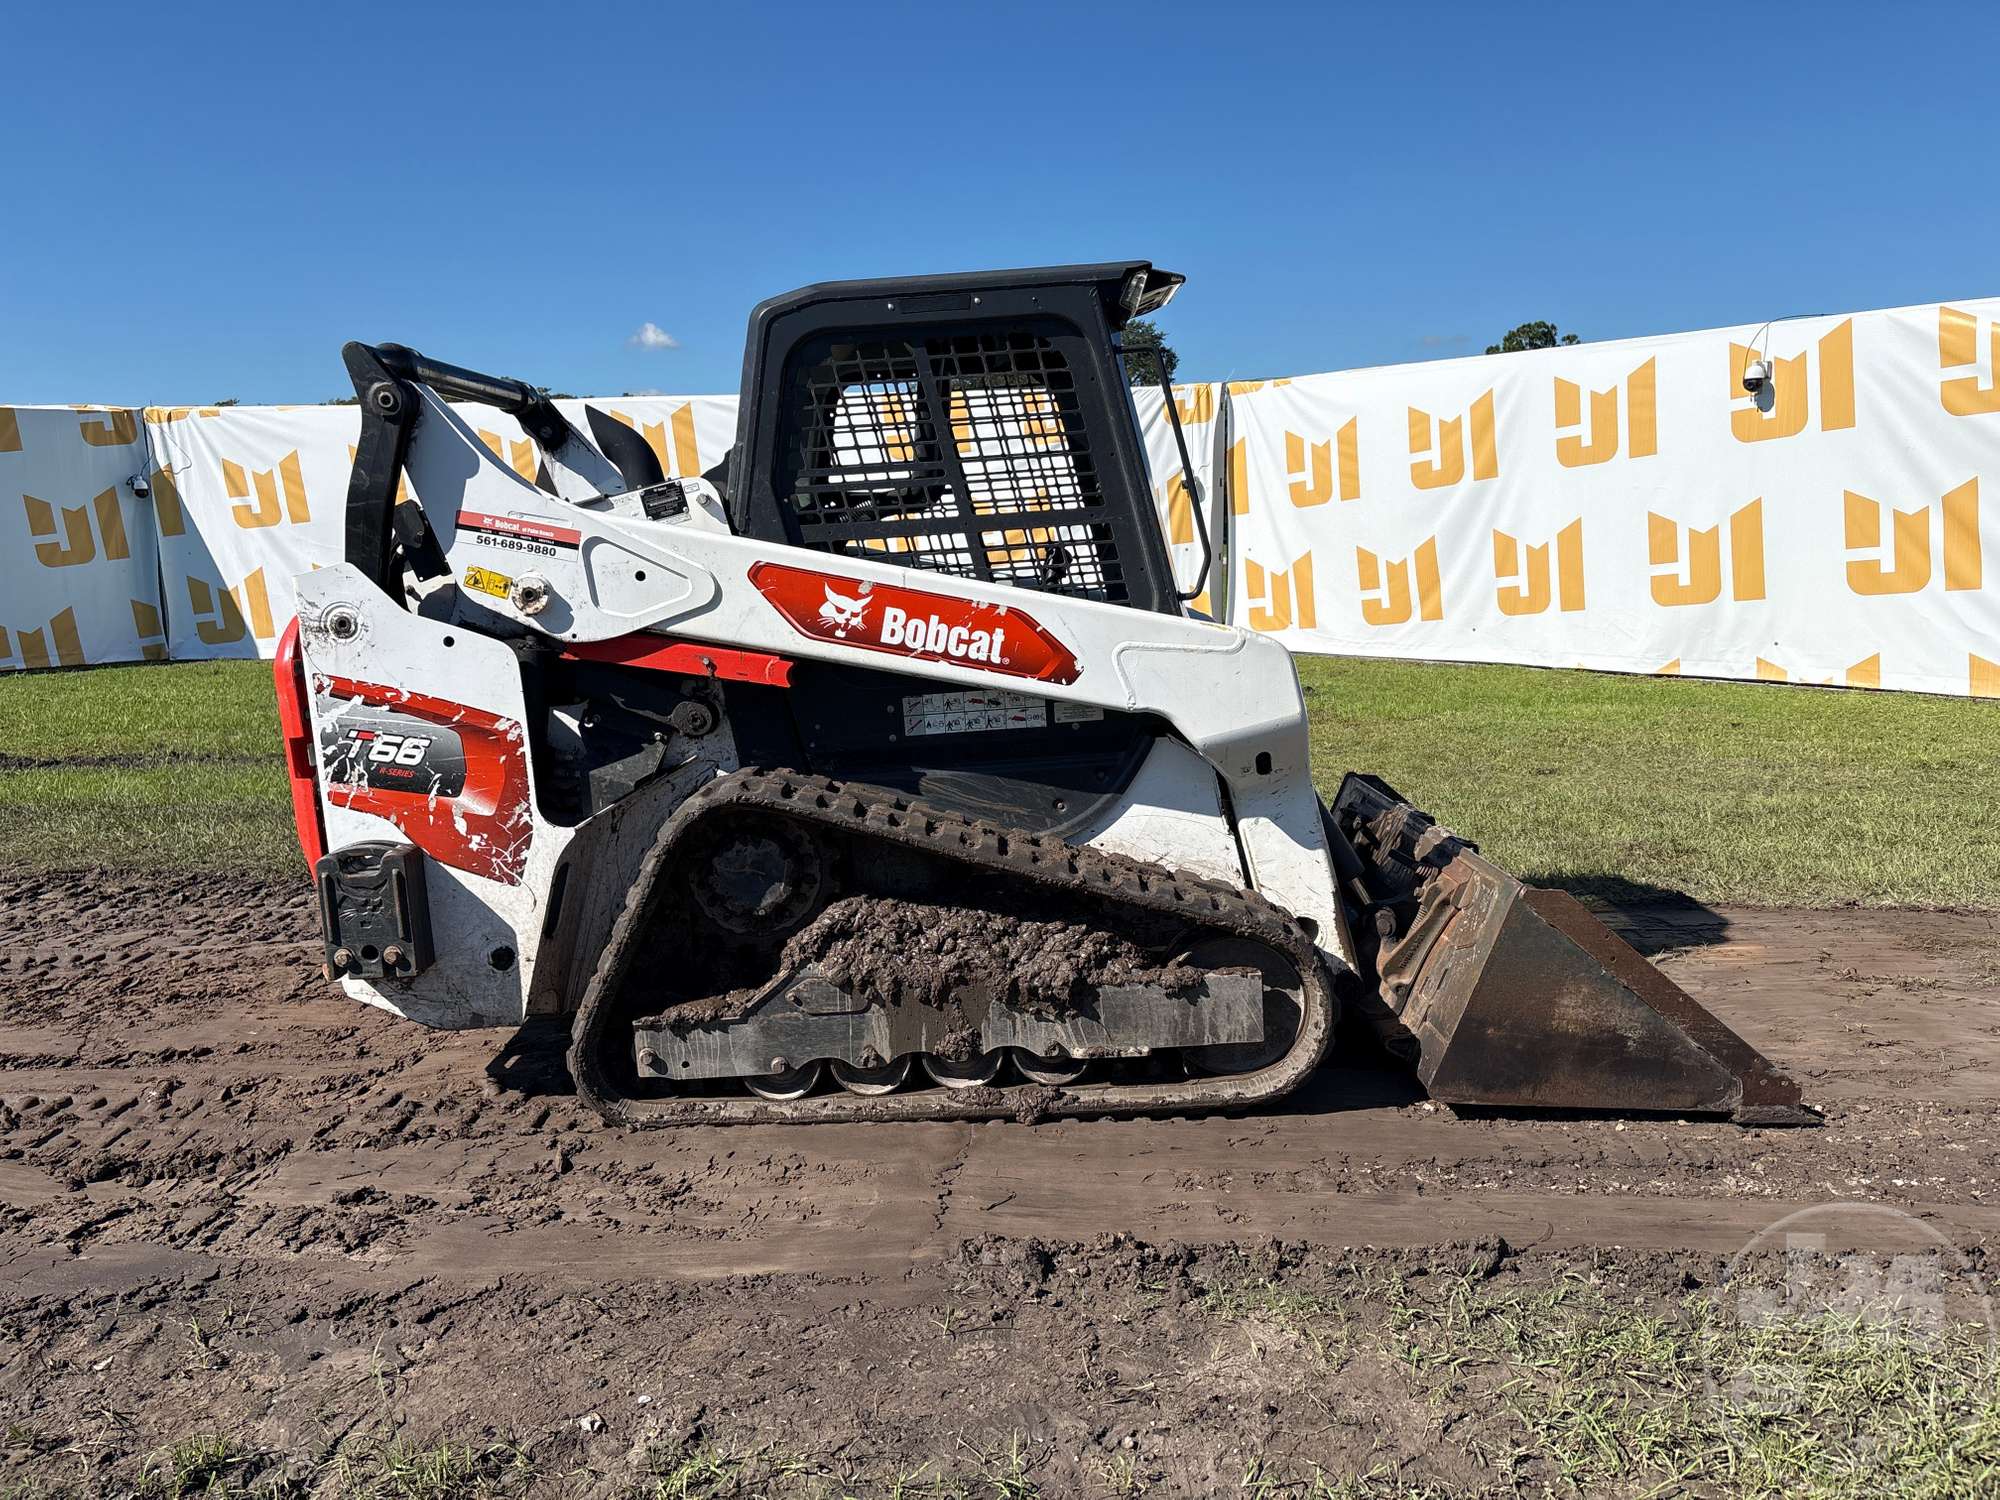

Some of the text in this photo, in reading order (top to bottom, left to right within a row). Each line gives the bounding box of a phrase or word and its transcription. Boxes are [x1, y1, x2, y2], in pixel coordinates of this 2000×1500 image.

[494, 519, 521, 532] Bobcat
[476, 535, 557, 557] 561-689-9880
[879, 606, 1006, 664] Bobcat
[345, 728, 433, 767] T66
